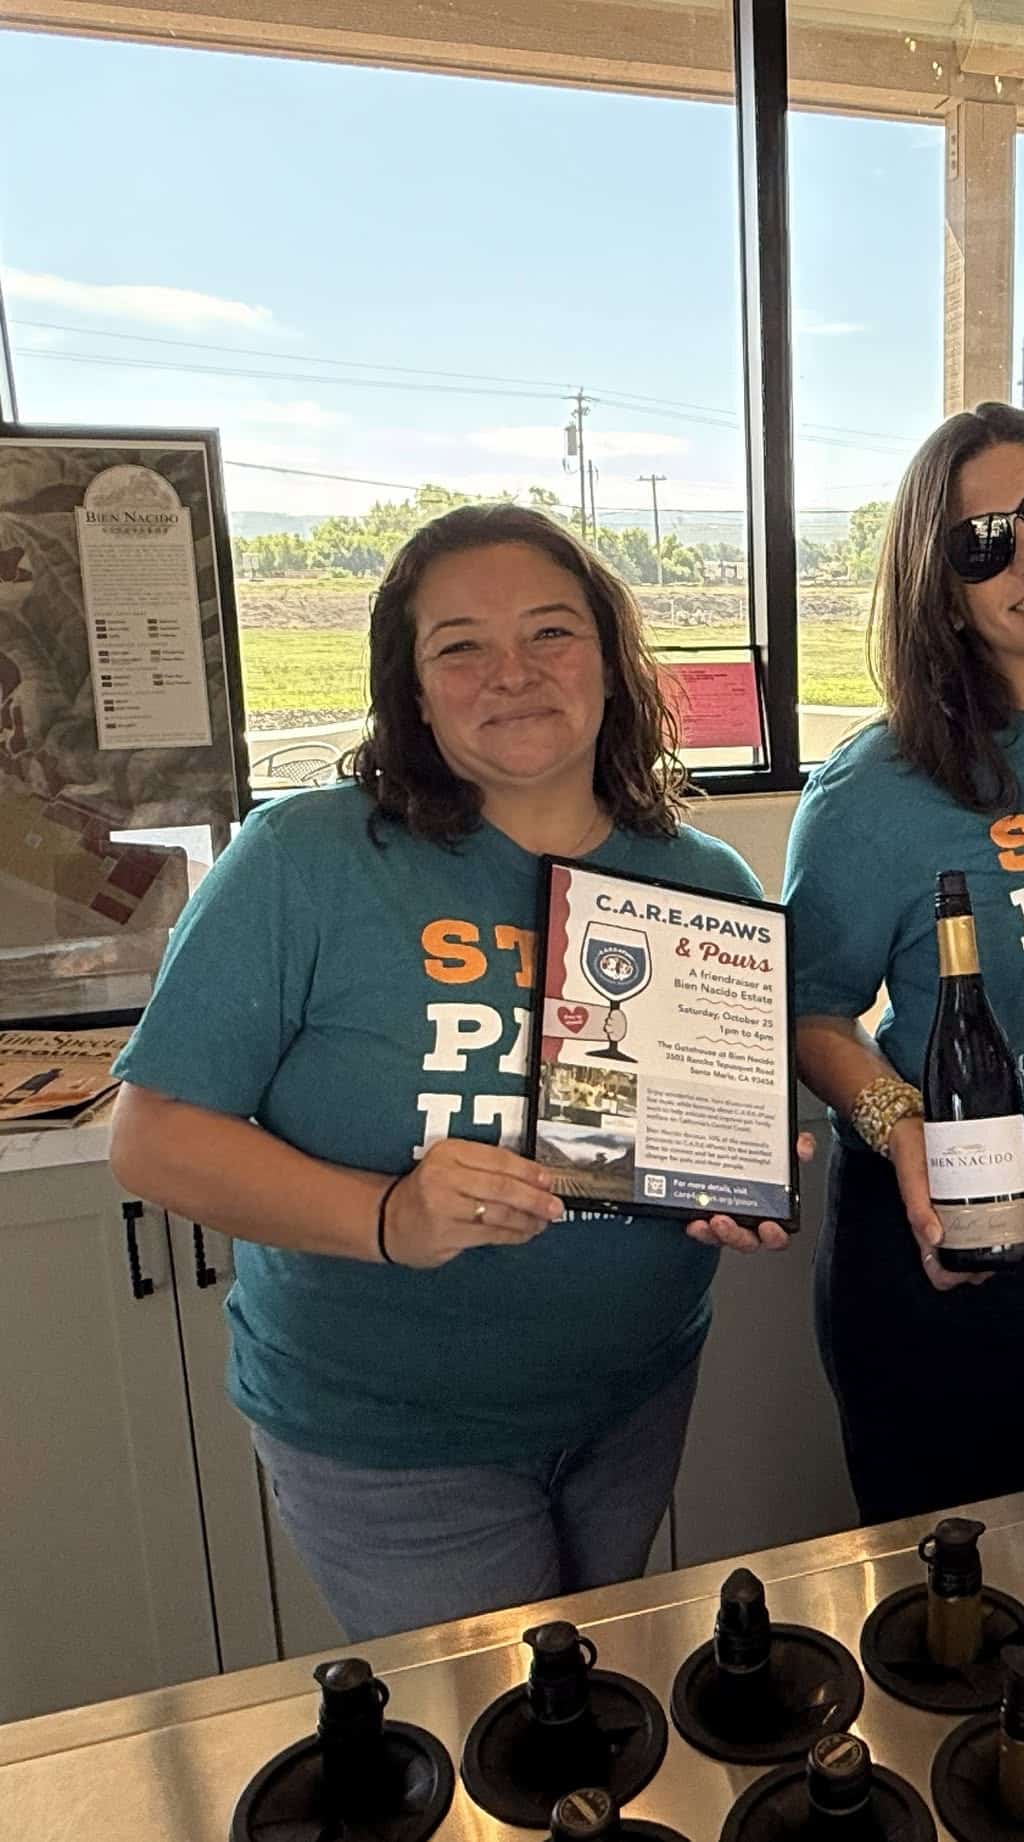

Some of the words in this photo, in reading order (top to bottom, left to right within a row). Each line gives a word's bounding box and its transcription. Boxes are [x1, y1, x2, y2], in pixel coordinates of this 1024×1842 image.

[595, 893, 770, 944] C.A.R.E.4PAWS
[421, 919, 537, 988] ST
[675, 936, 690, 957] &
[699, 940, 773, 974] Pours
[674, 978, 696, 991] Bien
[700, 983, 737, 998] Nacido
[740, 990, 772, 1004] Estate
[689, 967, 697, 977] A
[700, 969, 759, 989] friendraiser
[762, 983, 772, 992] at
[678, 1004, 719, 1020] Saturday,
[722, 1011, 759, 1025] October
[762, 1018, 772, 1028] 25
[719, 1025, 738, 1037] 1pm
[741, 1029, 751, 1037] to
[754, 1031, 773, 1042] 4pm
[958, 1152, 1013, 1166] NACIDO
